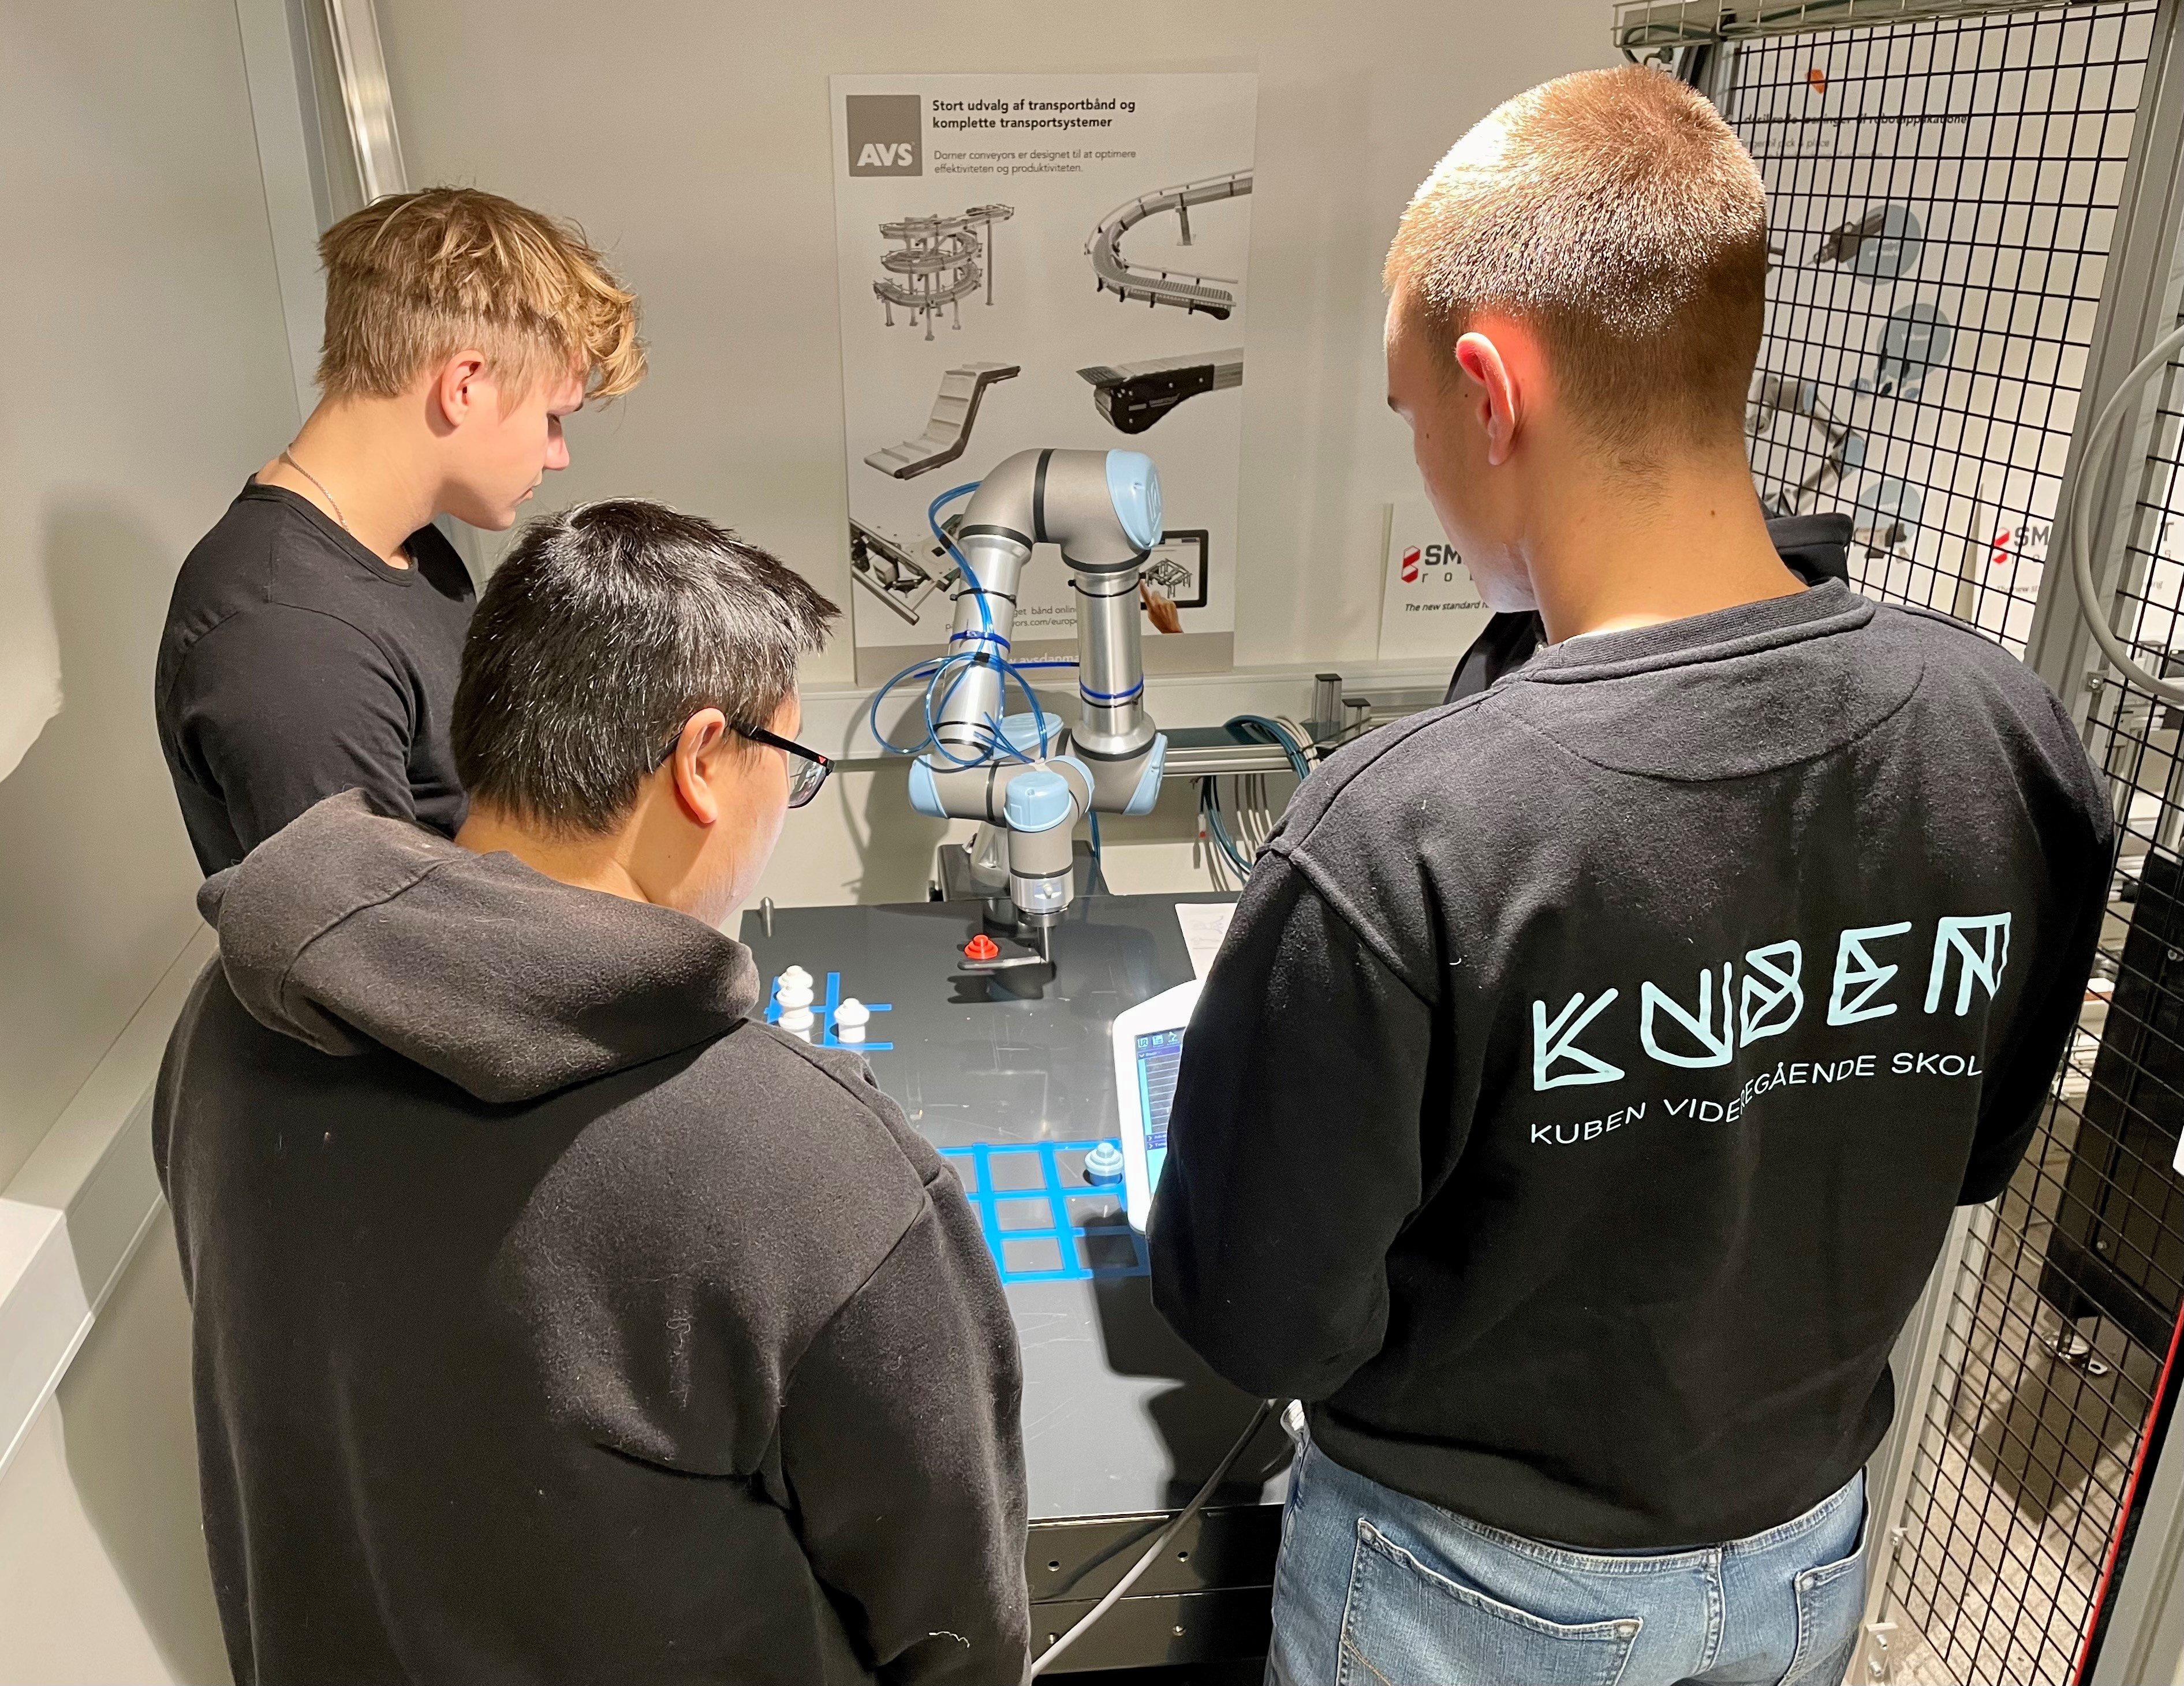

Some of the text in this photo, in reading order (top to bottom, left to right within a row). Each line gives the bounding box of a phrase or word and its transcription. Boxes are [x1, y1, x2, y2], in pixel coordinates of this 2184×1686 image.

[932, 98, 1136, 114] Stort udvalg af transportbånd og
[932, 117, 1113, 132] komplette transportsystemer
[856, 143, 913, 166] AVS
[934, 150, 967, 160] Dorner
[969, 152, 1016, 162] conveyors
[1029, 149, 1070, 162] designet
[1072, 149, 1081, 159] til
[1083, 151, 1093, 159] at
[1095, 149, 1137, 160] optimere
[934, 163, 994, 174] effektiviteten
[996, 166, 1009, 175] og
[1031, 606, 1053, 615] bånd
[1055, 605, 1077, 614] onlin
[1405, 603, 1420, 612] The
[1443, 601, 1481, 611] standard
[1532, 911, 2012, 1091] KUBEN
[1530, 1102, 1646, 1145] KUBEN
[1663, 1055, 1877, 1123] VIDEREGÅENDE
